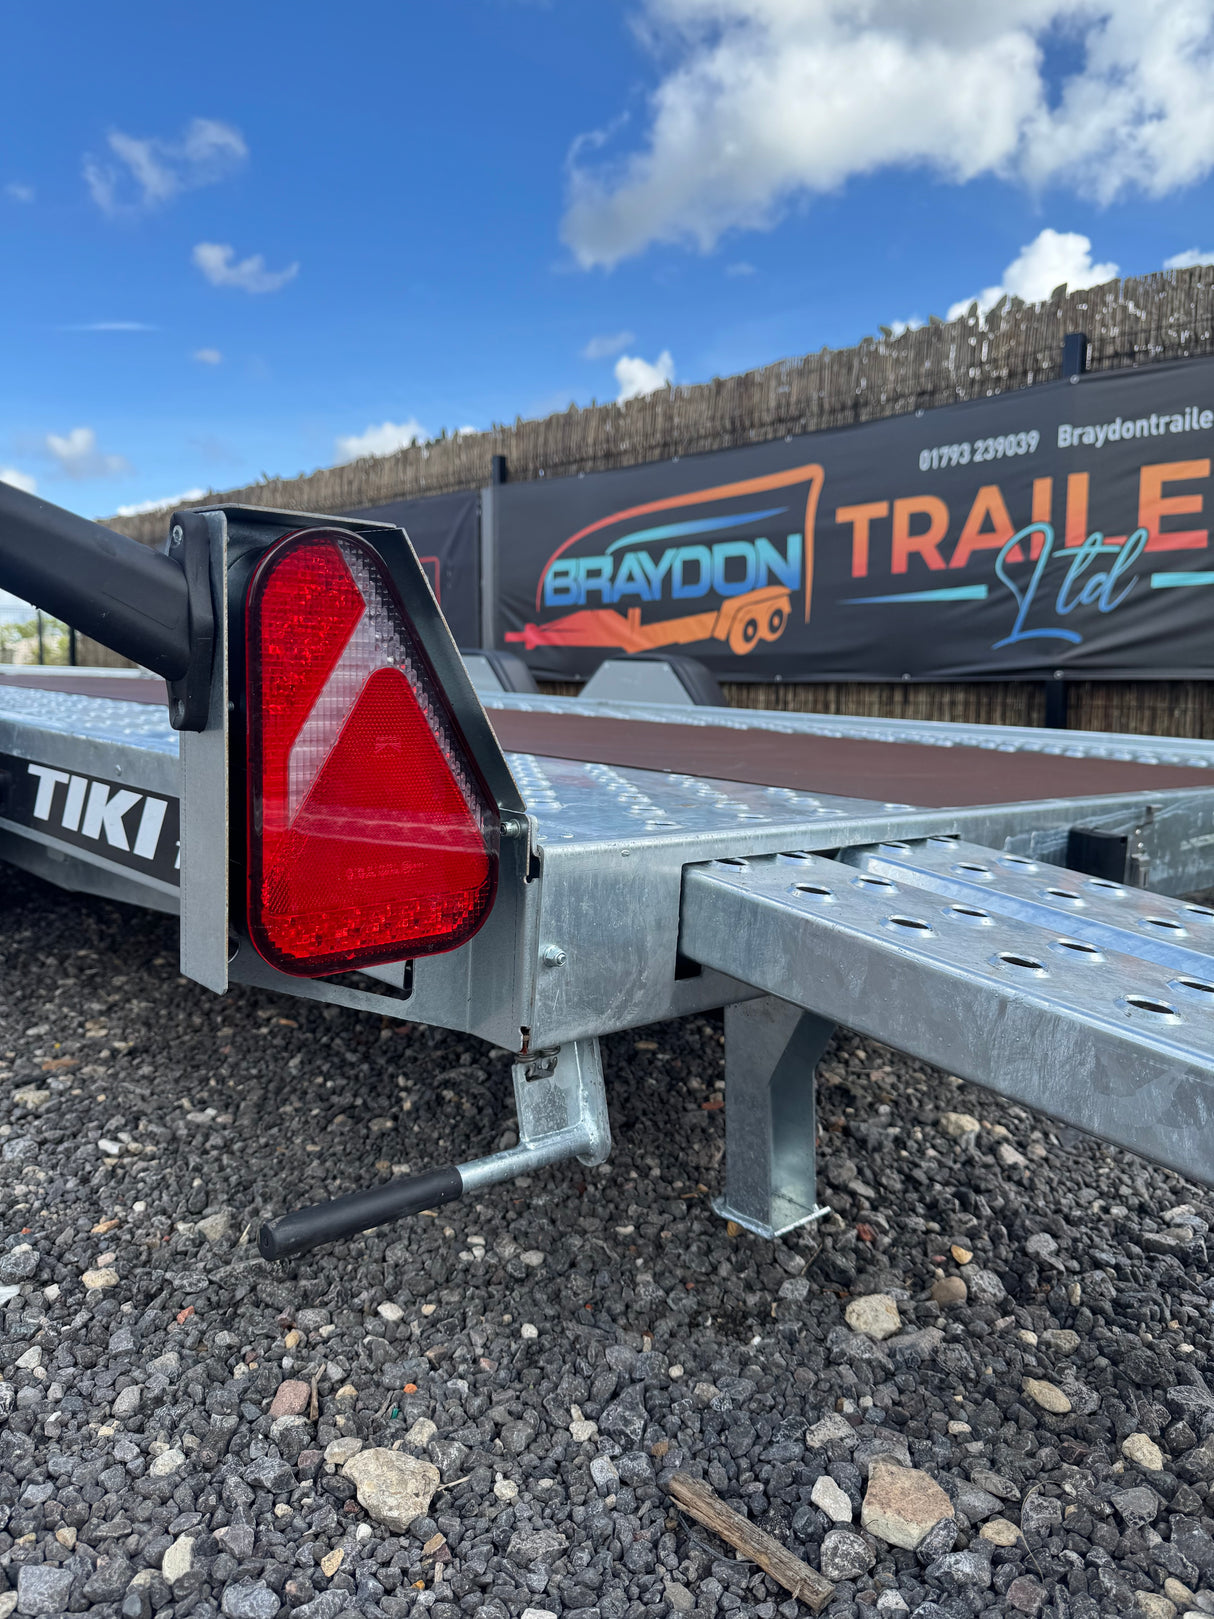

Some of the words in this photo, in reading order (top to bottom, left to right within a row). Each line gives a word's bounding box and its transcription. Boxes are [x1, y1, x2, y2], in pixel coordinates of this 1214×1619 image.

[919, 442, 971, 471] 01793
[973, 430, 1040, 463] 239039
[1057, 406, 1214, 449] Braydontraile
[835, 458, 1211, 578] TRAILE
[544, 533, 803, 607] BRAYDON
[992, 522, 1149, 649] Ltd
[27, 763, 168, 861] TIKI
